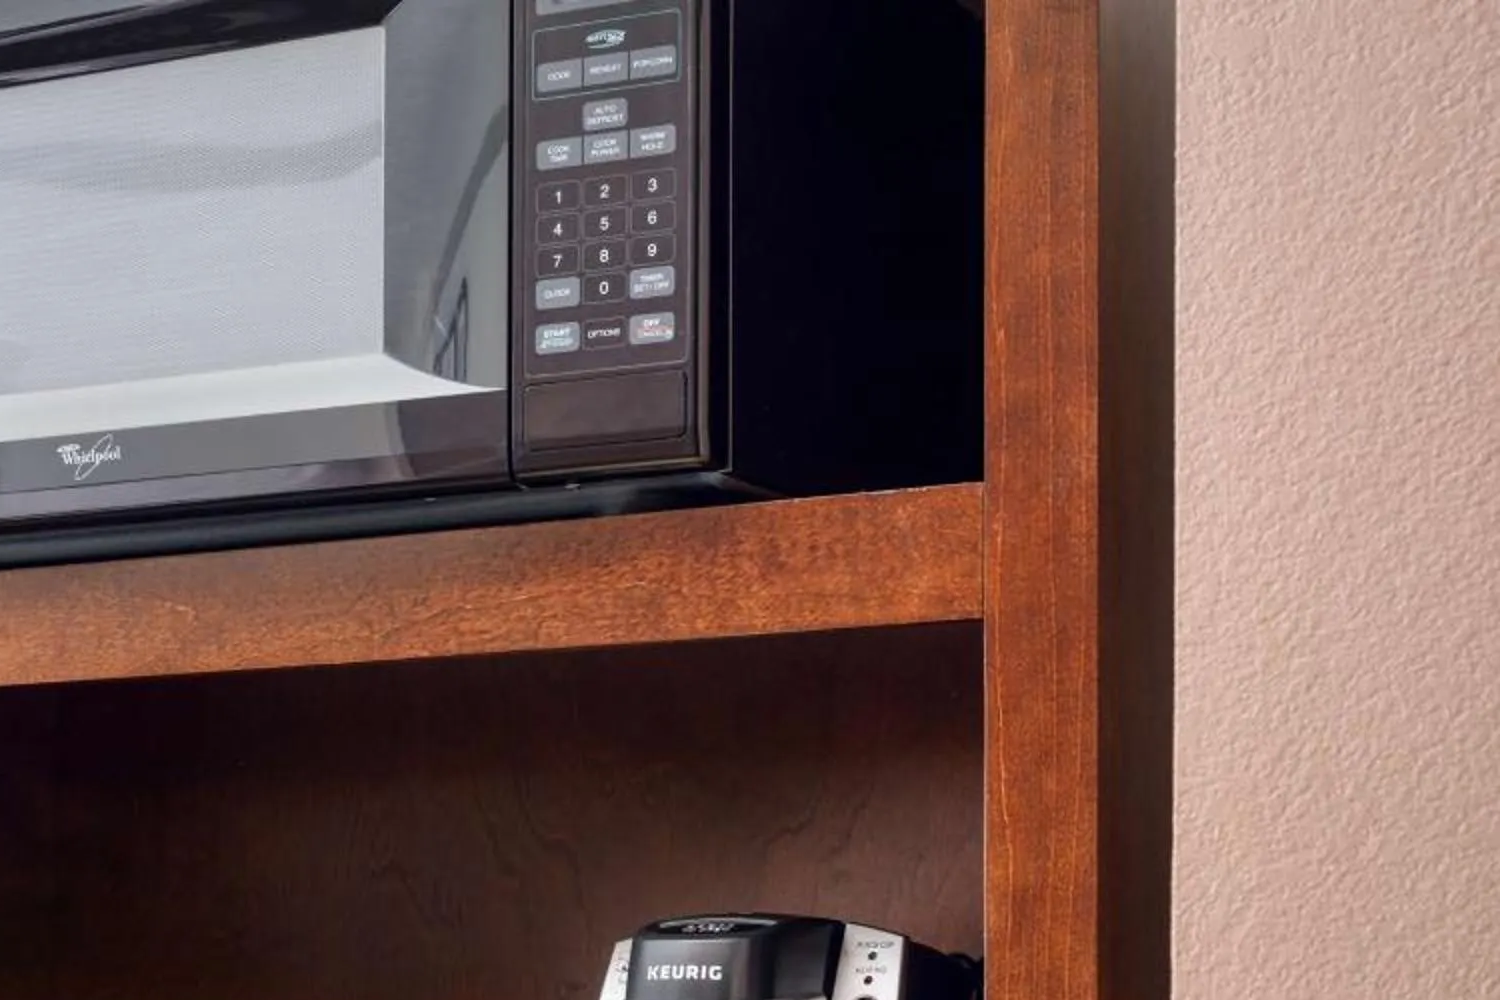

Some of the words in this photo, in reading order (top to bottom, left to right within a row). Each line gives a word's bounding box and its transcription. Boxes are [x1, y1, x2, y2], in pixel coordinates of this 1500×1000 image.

[555, 190, 562, 204] 1
[600, 183, 610, 199] 2
[648, 177, 658, 192] 3
[553, 222, 563, 236] 4
[600, 215, 610, 231] 5
[647, 209, 658, 225] 6
[553, 254, 563, 268] 7
[599, 248, 609, 263] 8
[647, 242, 657, 257] 9
[599, 281, 609, 295] 0
[647, 964, 723, 980] KEURIG
